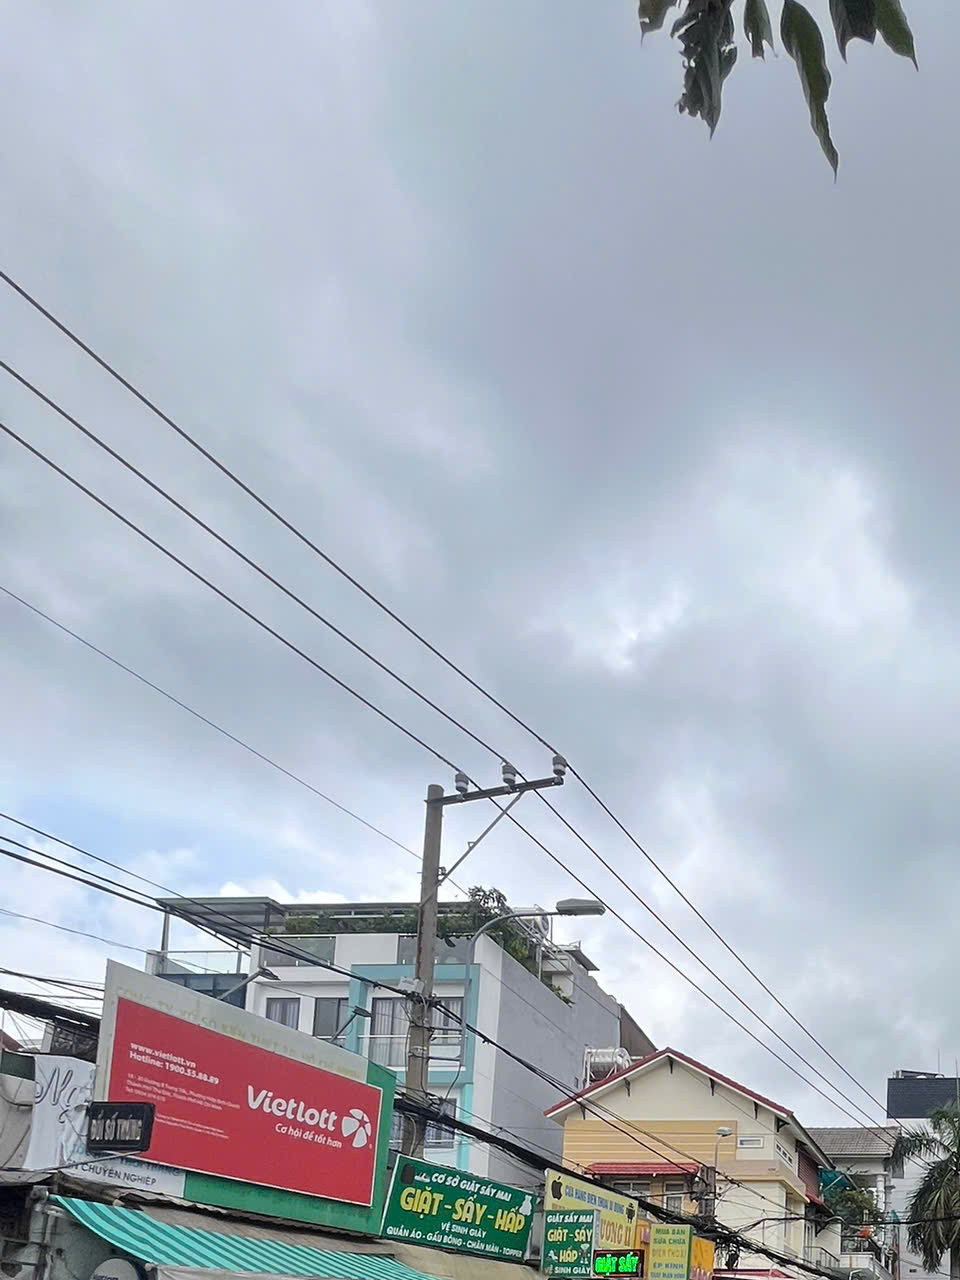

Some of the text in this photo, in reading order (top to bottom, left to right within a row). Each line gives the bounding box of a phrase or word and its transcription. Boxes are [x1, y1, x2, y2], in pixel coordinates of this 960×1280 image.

[129, 1051, 164, 1068] Hotline:
[130, 1042, 196, 1069] www.vietlott.vn
[247, 1085, 338, 1131] Vietlott
[275, 1122, 287, 1133] Cơ
[288, 1125, 302, 1139] hội
[81, 1161, 122, 1179] CHUYÊN
[122, 1172, 156, 1186] NGHIỆP
[431, 1172, 445, 1184] CƠ
[445, 1175, 460, 1187] SỞ
[400, 1186, 444, 1219] GIẶT
[452, 1195, 488, 1225] SẤY
[494, 1206, 525, 1233] HẤP
[409, 1227, 422, 1239] ÁO
[441, 1222, 450, 1233] VỆ
[451, 1224, 468, 1235] SINH
[547, 1227, 568, 1244] GIẶT
[574, 1225, 593, 1242] SẤY
[595, 1251, 639, 1276] GIẶT SẤY
